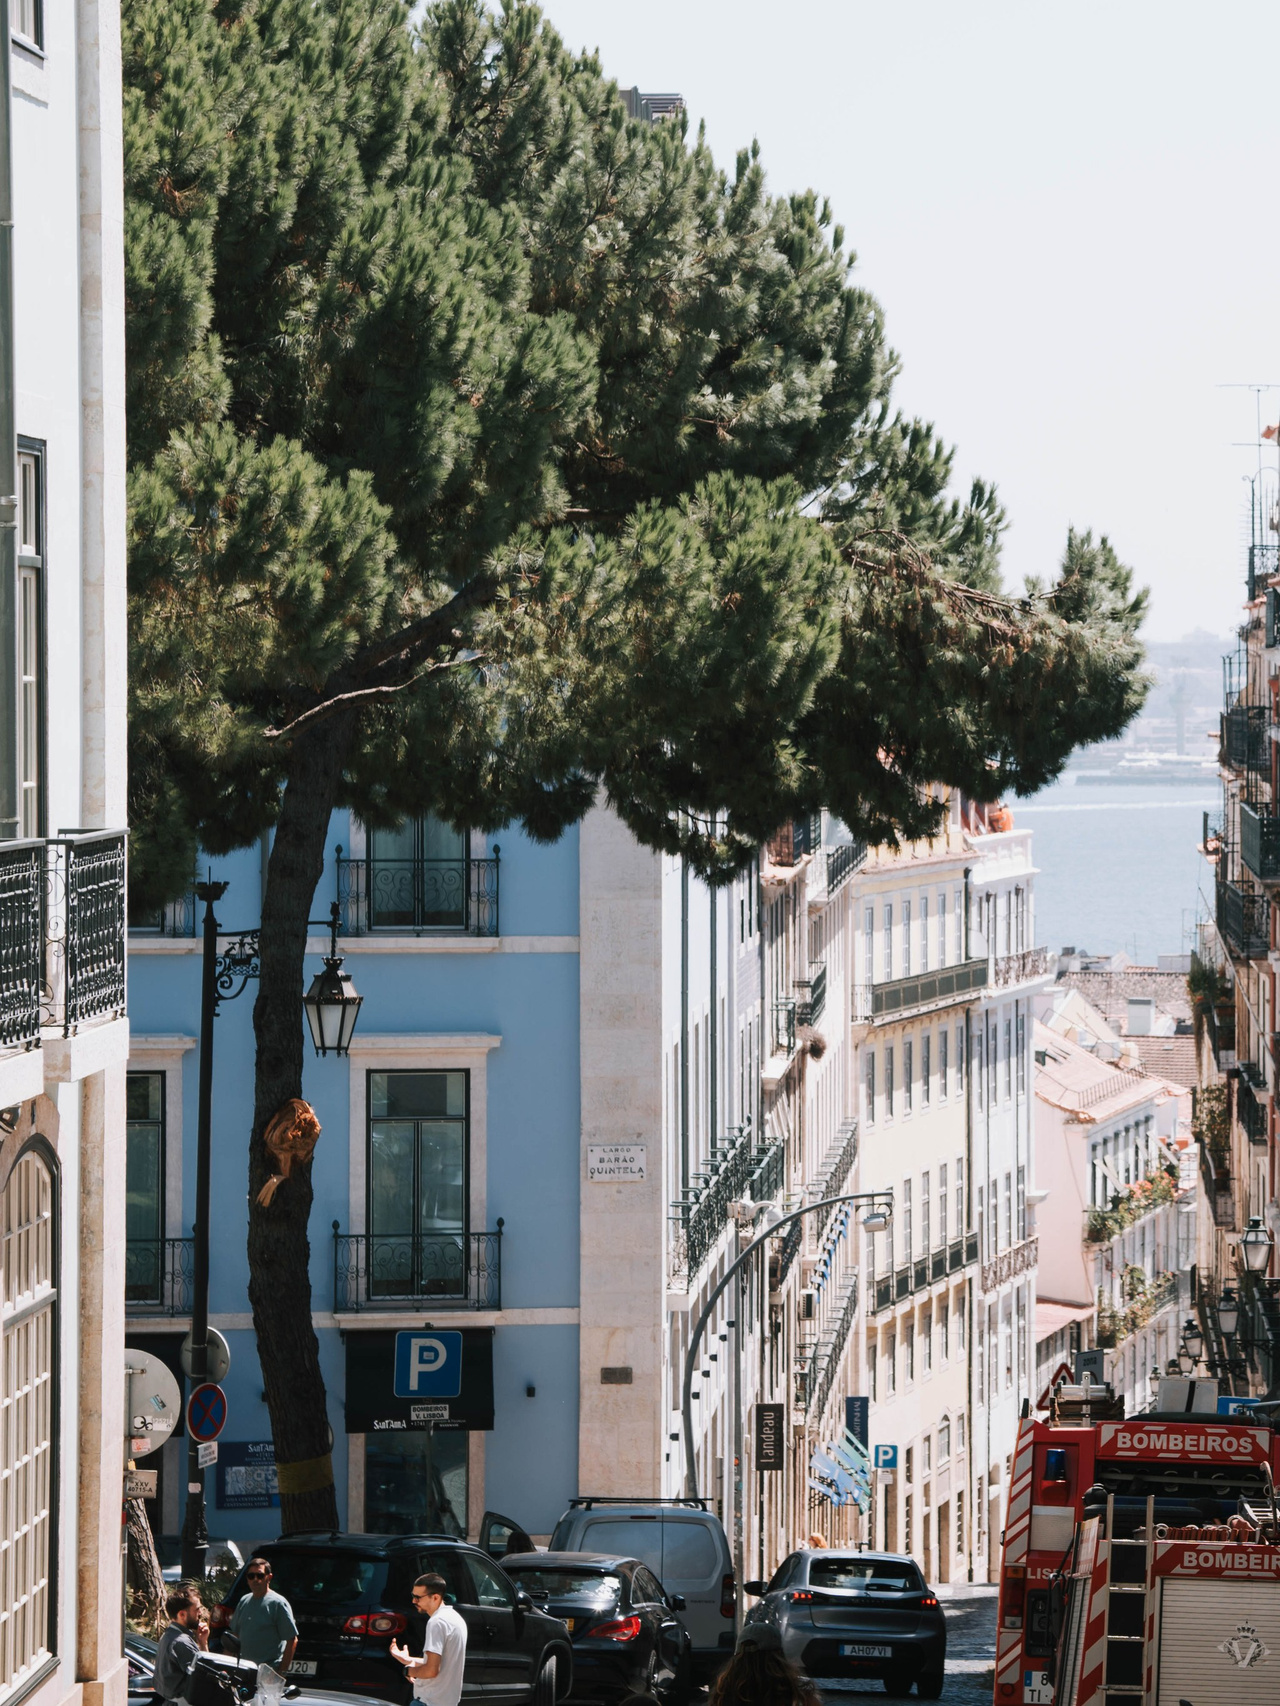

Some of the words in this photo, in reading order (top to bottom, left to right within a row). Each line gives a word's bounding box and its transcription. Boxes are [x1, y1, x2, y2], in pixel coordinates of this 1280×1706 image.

[589, 1166, 645, 1176] QUINTELA
[409, 1338, 447, 1391] P
[412, 1405, 448, 1413] BOMBEIROS
[760, 1411, 775, 1463] landeau
[1117, 1432, 1253, 1454] BOMBEIROS
[878, 1445, 894, 1467] P
